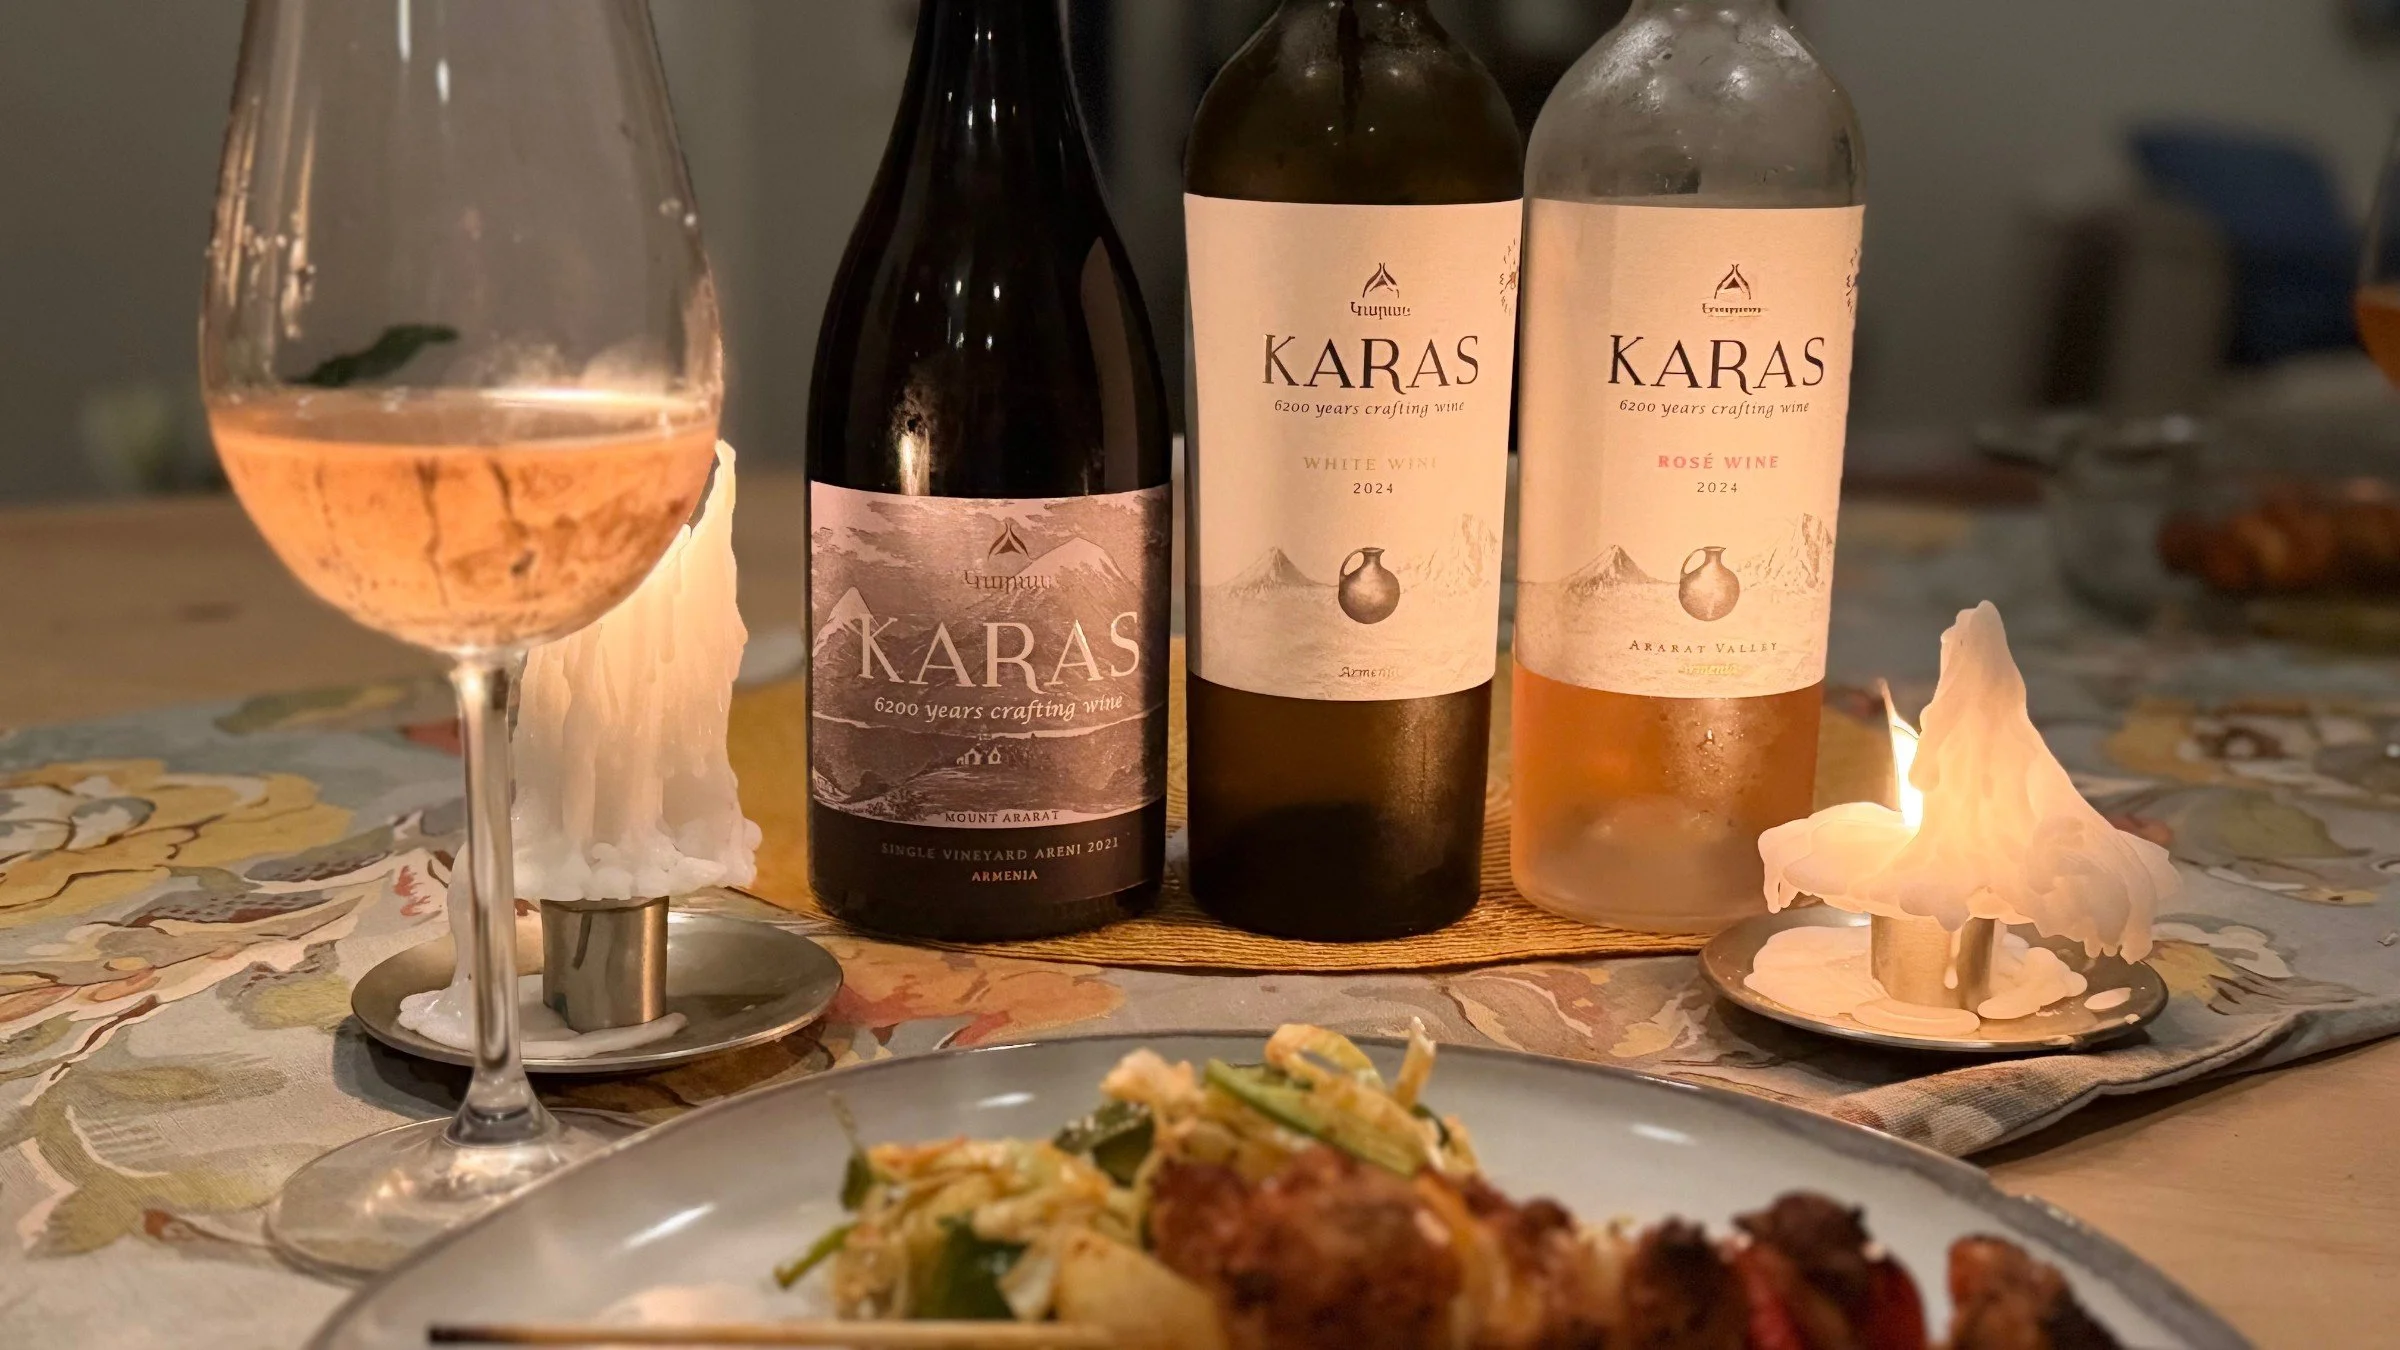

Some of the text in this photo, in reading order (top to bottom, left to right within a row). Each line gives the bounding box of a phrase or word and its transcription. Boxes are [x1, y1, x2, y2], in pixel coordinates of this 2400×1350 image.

[1262, 333, 1479, 395] KARAS
[1608, 334, 1825, 395] KARAS
[1274, 400, 1310, 413] 6200
[1315, 402, 1359, 418] years
[1365, 400, 1429, 419] crafting
[1619, 400, 1810, 419] 6200 years crafting wine
[1303, 456, 1376, 471] WHITE
[1658, 453, 1779, 469] ROSÉ WINE
[1353, 482, 1393, 494] 2024
[1697, 481, 1738, 493] 2024
[857, 611, 1140, 694] KARAS
[1629, 640, 1778, 653] ARARAT VALLEY
[874, 694, 1123, 725] 6200 years crafting wine
[944, 810, 1060, 824] MOUNT ARARAT
[881, 837, 1119, 862] SINGLE VINEYARD ARENI 2021
[971, 869, 1038, 883] ARMENIA
